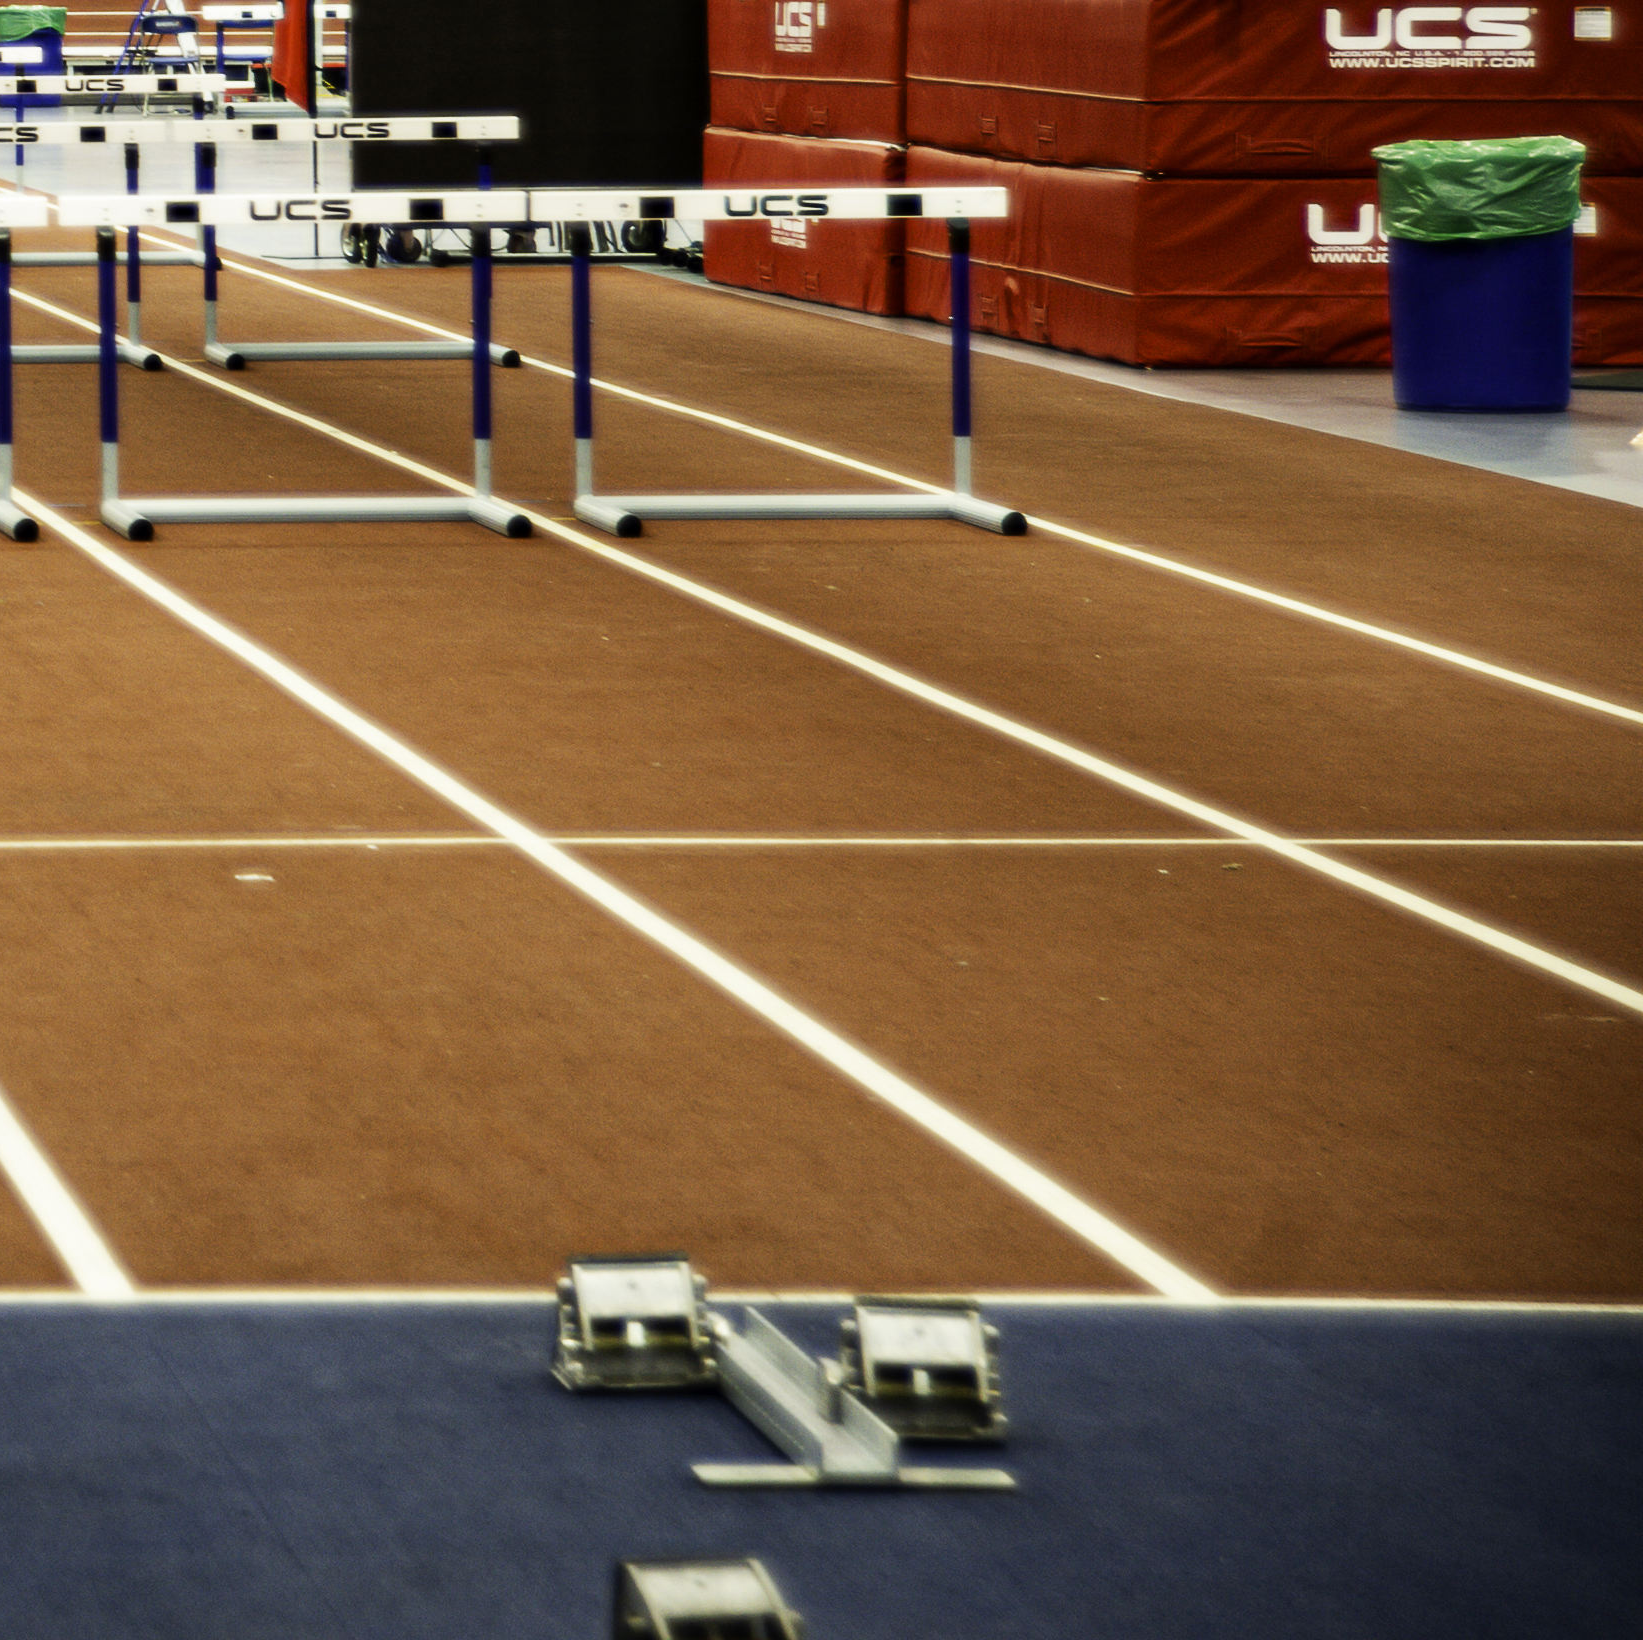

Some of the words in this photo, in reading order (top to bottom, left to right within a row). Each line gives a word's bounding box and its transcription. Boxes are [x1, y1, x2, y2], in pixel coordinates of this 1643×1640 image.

[775, 1, 813, 37] UCS
[1326, 7, 1532, 50] UCS
[1330, 57, 1535, 68] WWW.UCSSPIRIT.COM
[65, 78, 124, 92] UCS
[314, 122, 390, 139] UCS
[250, 199, 351, 221] UCS
[724, 195, 829, 217] UCS
